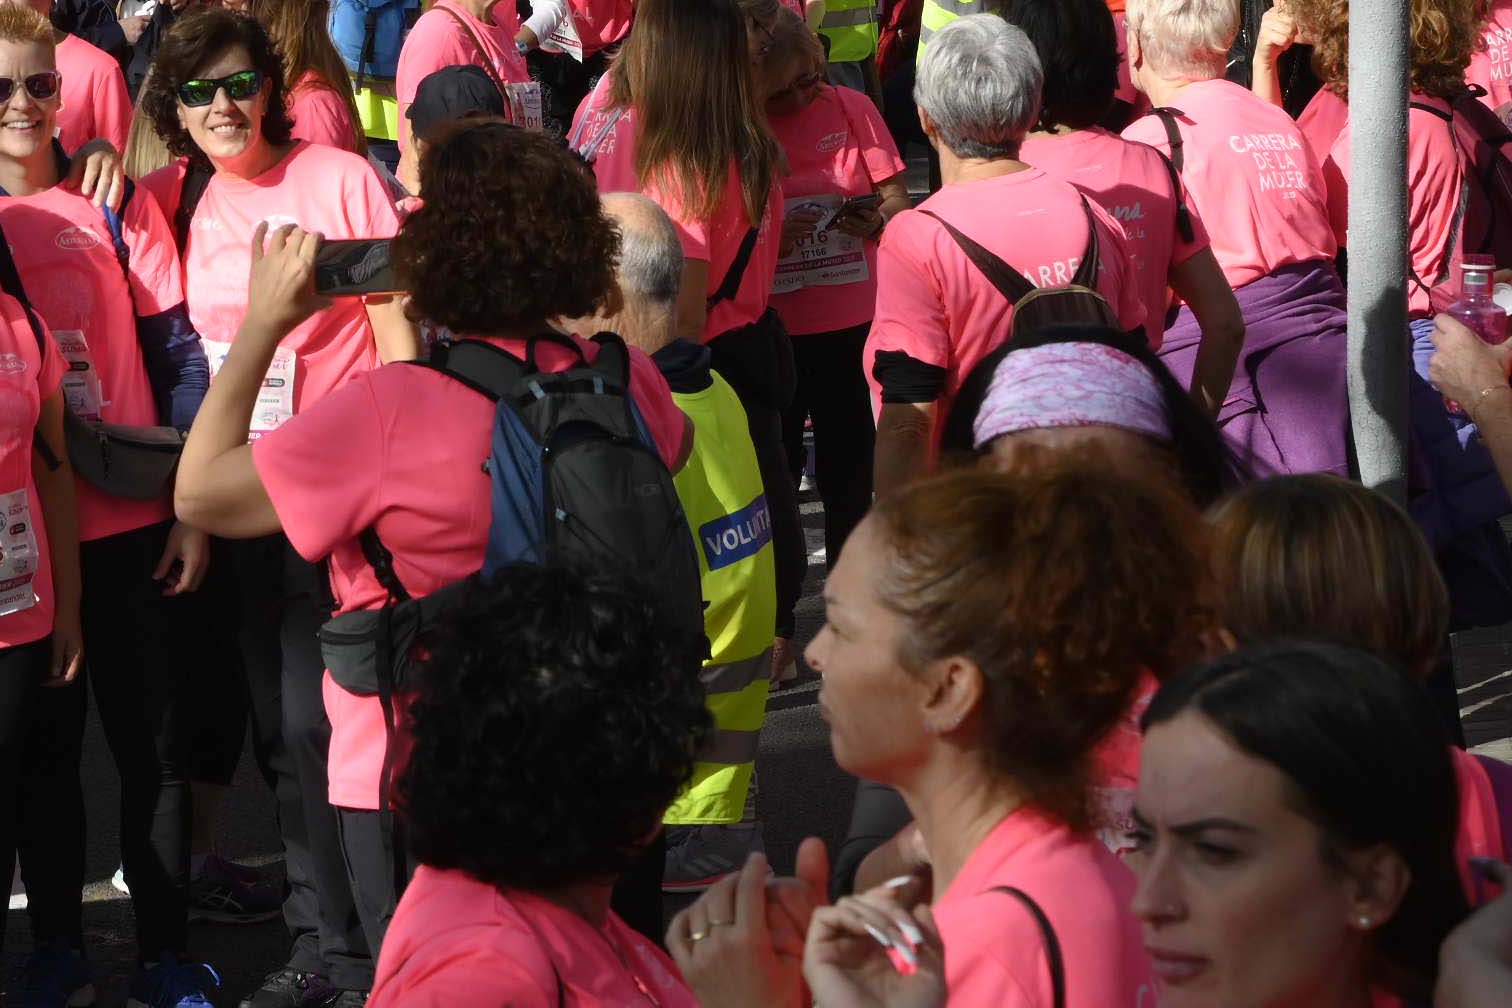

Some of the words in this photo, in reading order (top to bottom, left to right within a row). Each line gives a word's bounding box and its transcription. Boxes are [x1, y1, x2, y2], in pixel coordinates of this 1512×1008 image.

[1228, 133, 1302, 154] CARRERA
[1254, 152, 1275, 171] DE
[1277, 153, 1298, 170] LA
[1257, 170, 1307, 193] MUJER
[705, 505, 771, 556] VOLUNT
